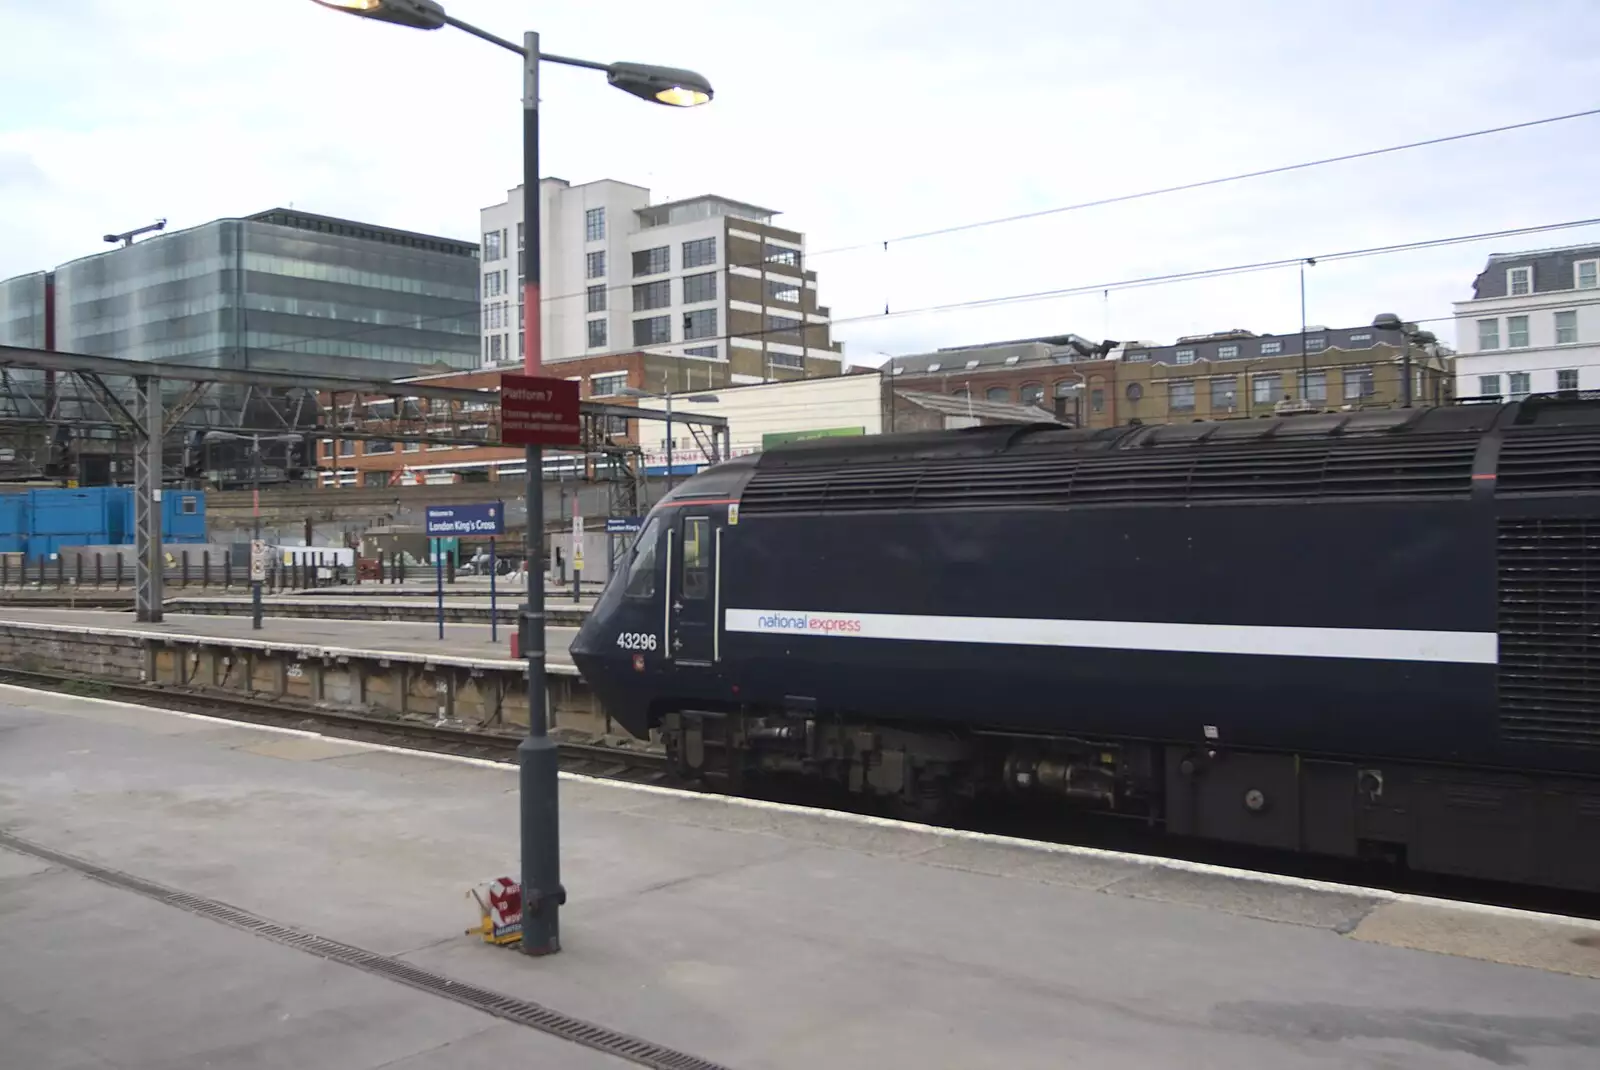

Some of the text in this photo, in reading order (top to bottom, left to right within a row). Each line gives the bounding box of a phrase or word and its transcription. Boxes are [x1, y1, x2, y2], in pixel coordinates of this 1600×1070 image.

[503, 387, 553, 402] Platform 7
[429, 519, 496, 532] London King's Cross
[758, 614, 861, 634] national express
[617, 632, 657, 651] 43296
